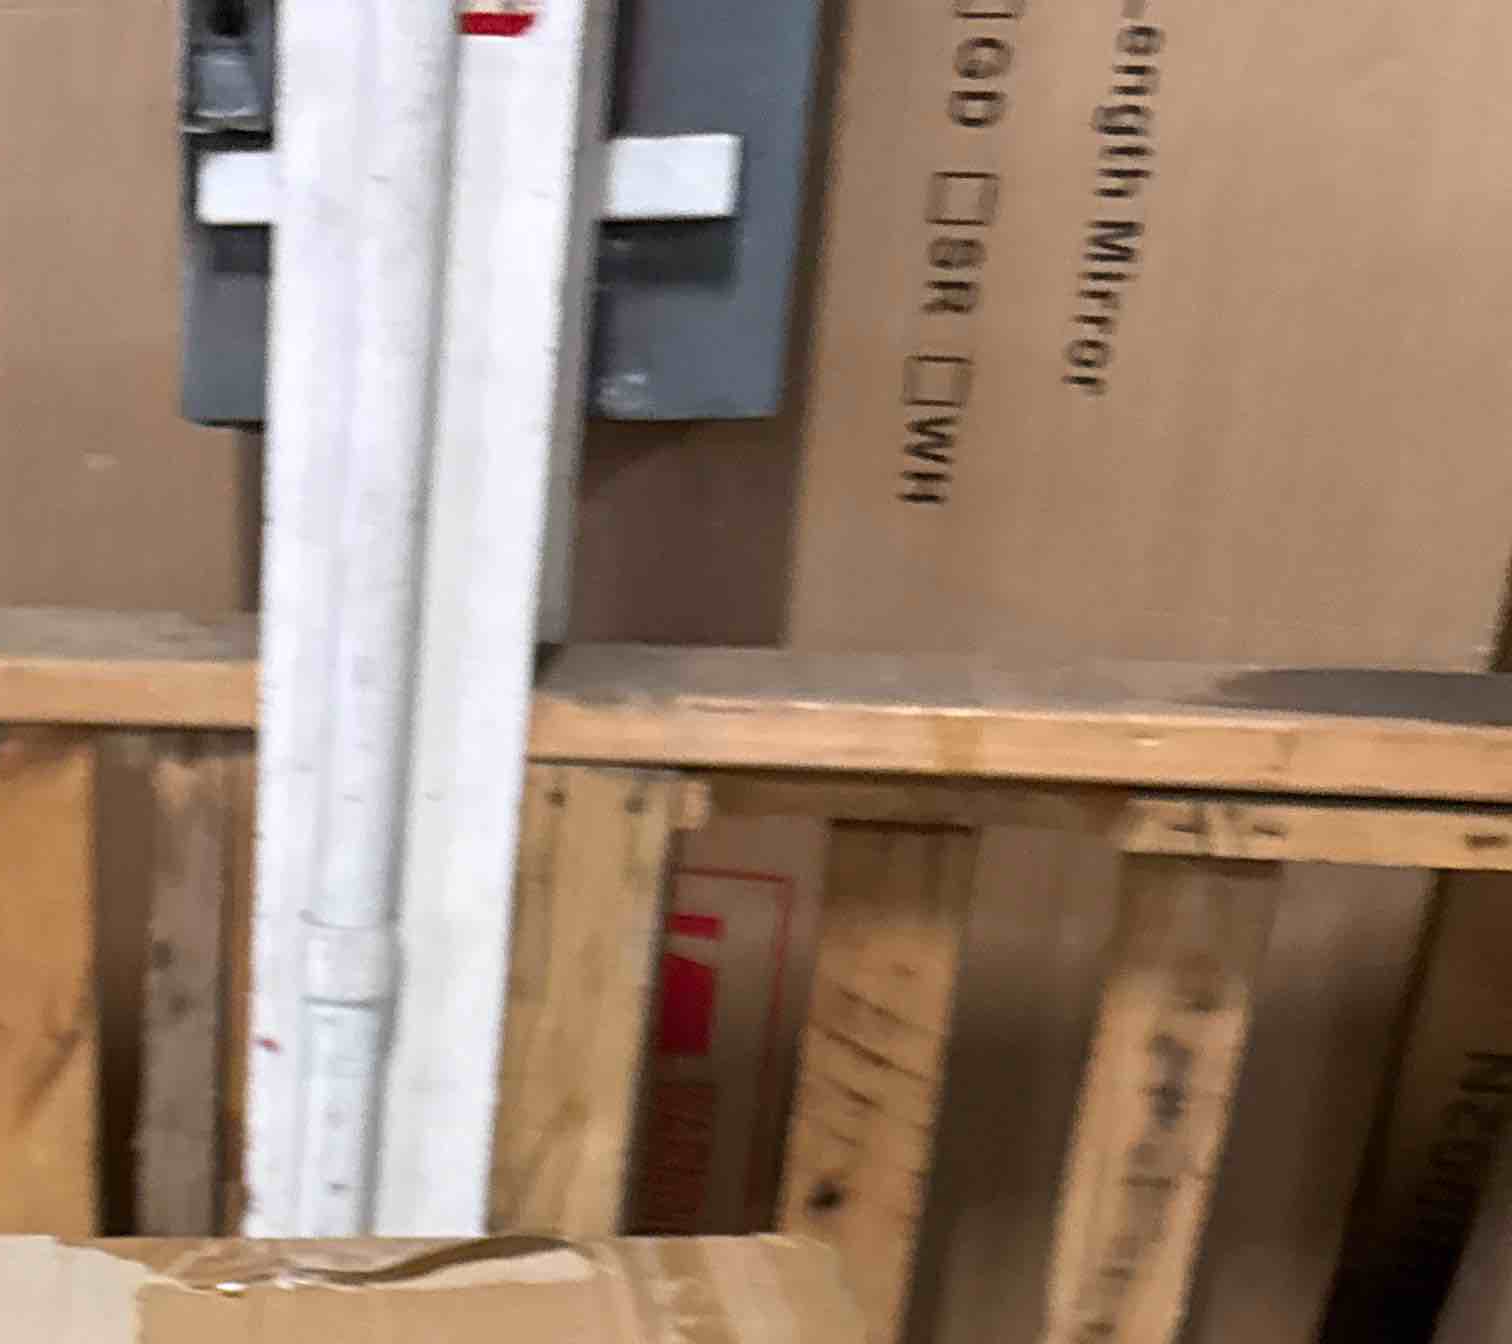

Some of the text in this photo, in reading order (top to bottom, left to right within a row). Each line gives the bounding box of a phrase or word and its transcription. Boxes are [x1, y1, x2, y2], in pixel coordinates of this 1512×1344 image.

[947, 36, 1016, 128] GD
[1060, 0, 1168, 398] ength Mirror
[896, 415, 962, 505] WH
